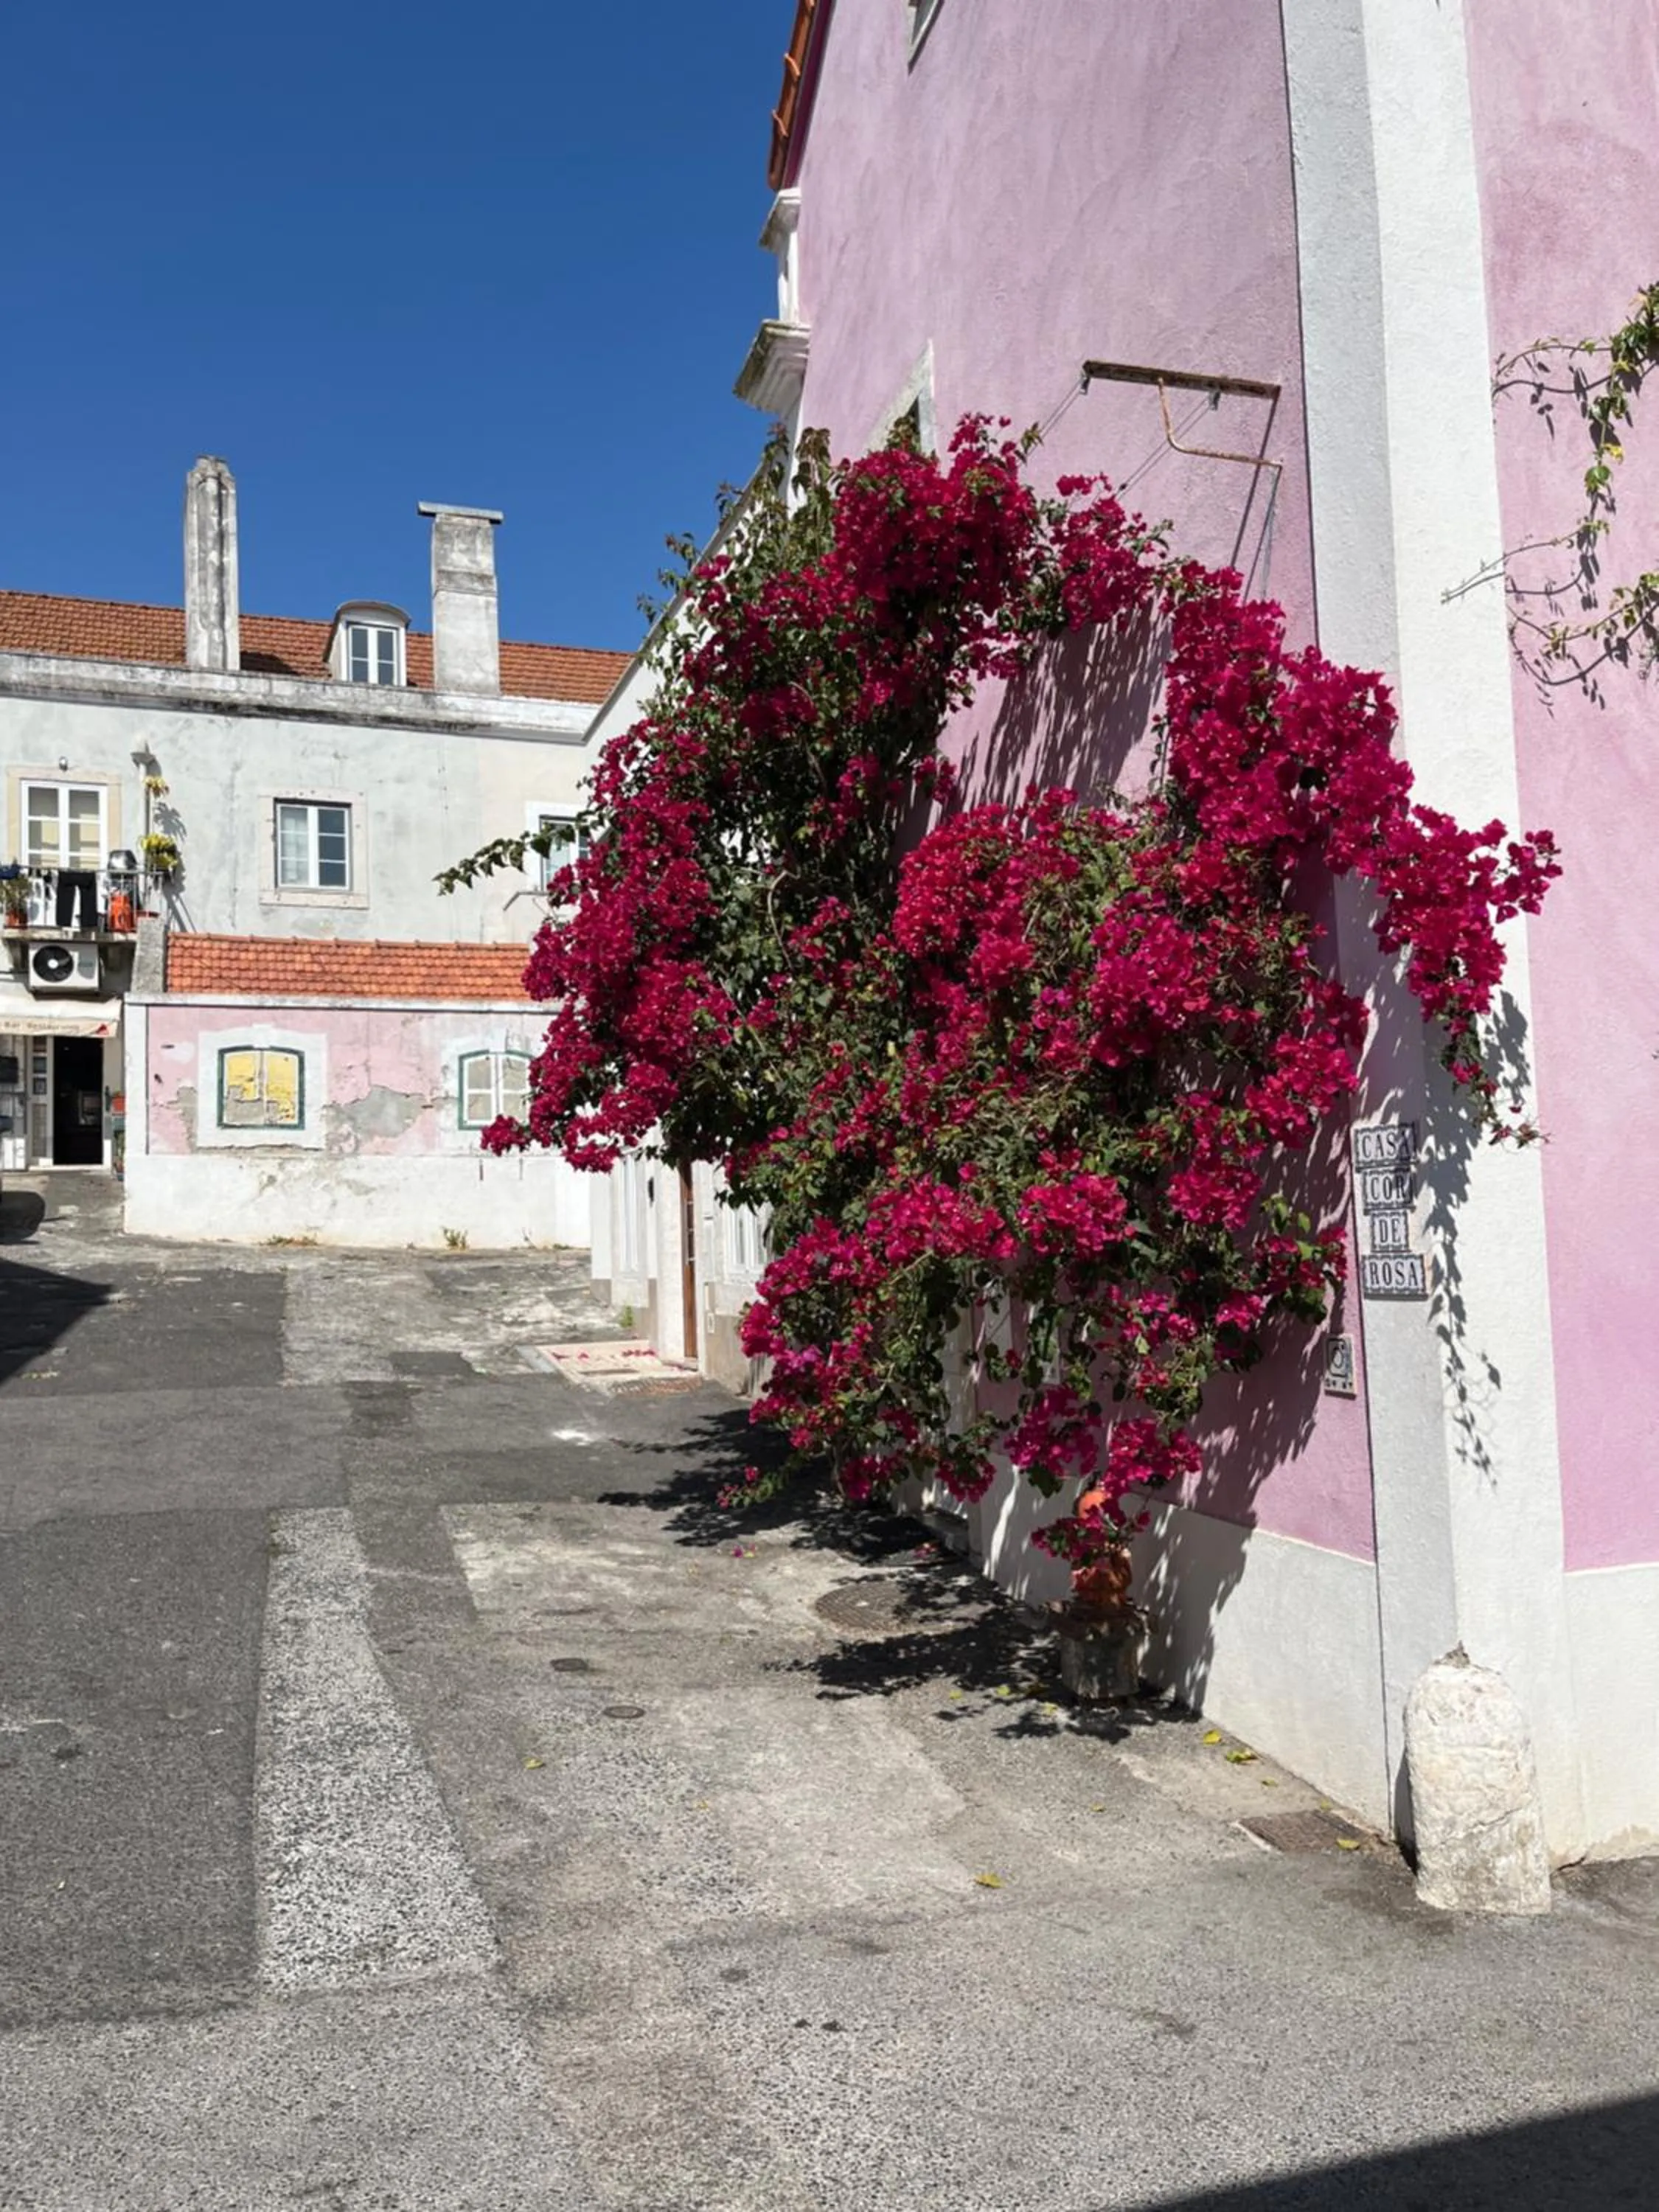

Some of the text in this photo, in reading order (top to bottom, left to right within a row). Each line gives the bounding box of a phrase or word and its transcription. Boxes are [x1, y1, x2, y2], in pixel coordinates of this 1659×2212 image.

[1362, 1130, 1410, 1160] CASA
[1371, 1175, 1408, 1200] COR
[1379, 1217, 1401, 1242] DE
[1369, 1260, 1418, 1286] ROSA
